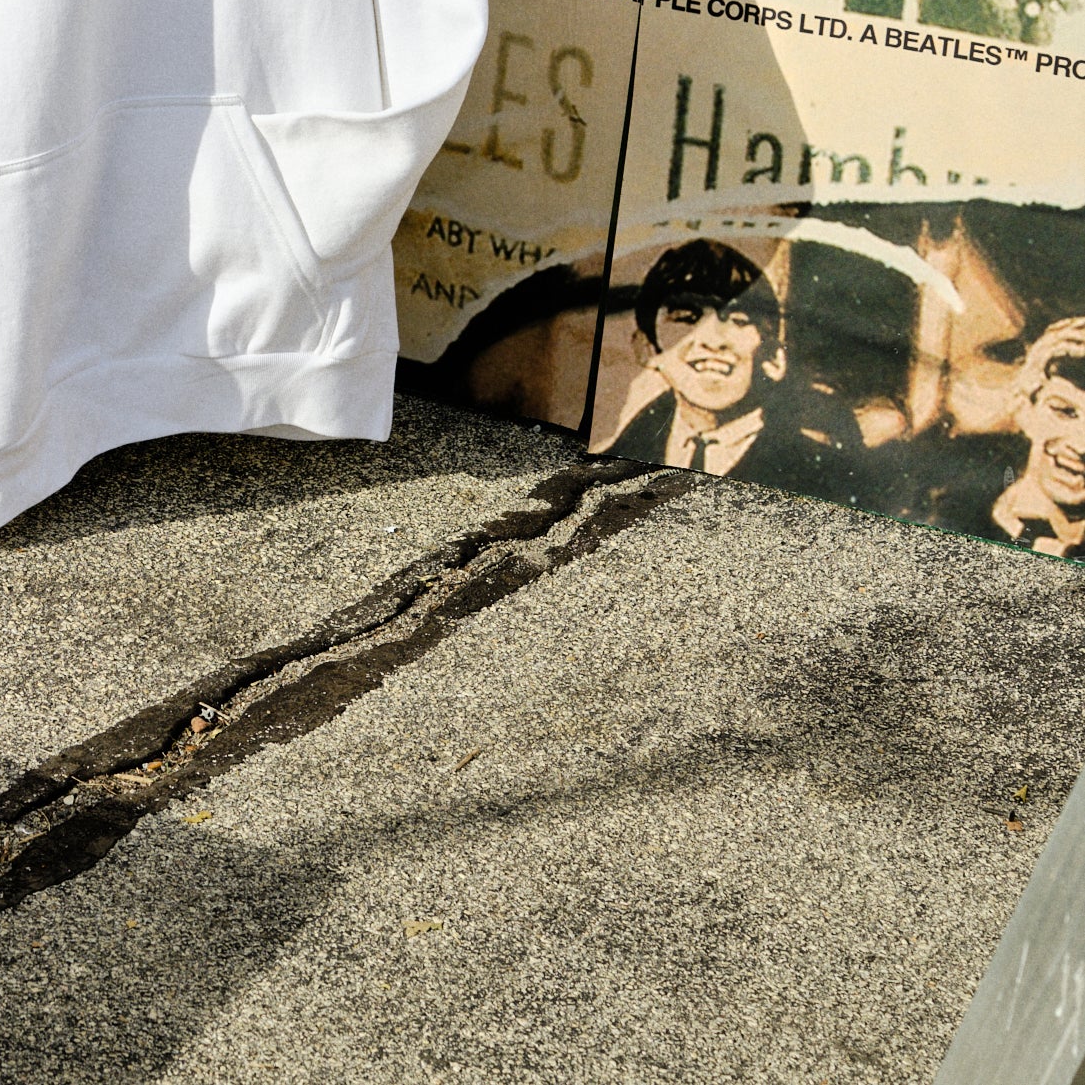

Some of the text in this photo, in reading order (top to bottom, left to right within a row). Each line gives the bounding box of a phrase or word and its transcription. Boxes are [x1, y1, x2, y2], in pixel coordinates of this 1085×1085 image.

[799, 13, 853, 42] LTD.
[859, 24, 878, 45] A
[443, 31, 595, 184] ES
[426, 216, 482, 254] ABY
